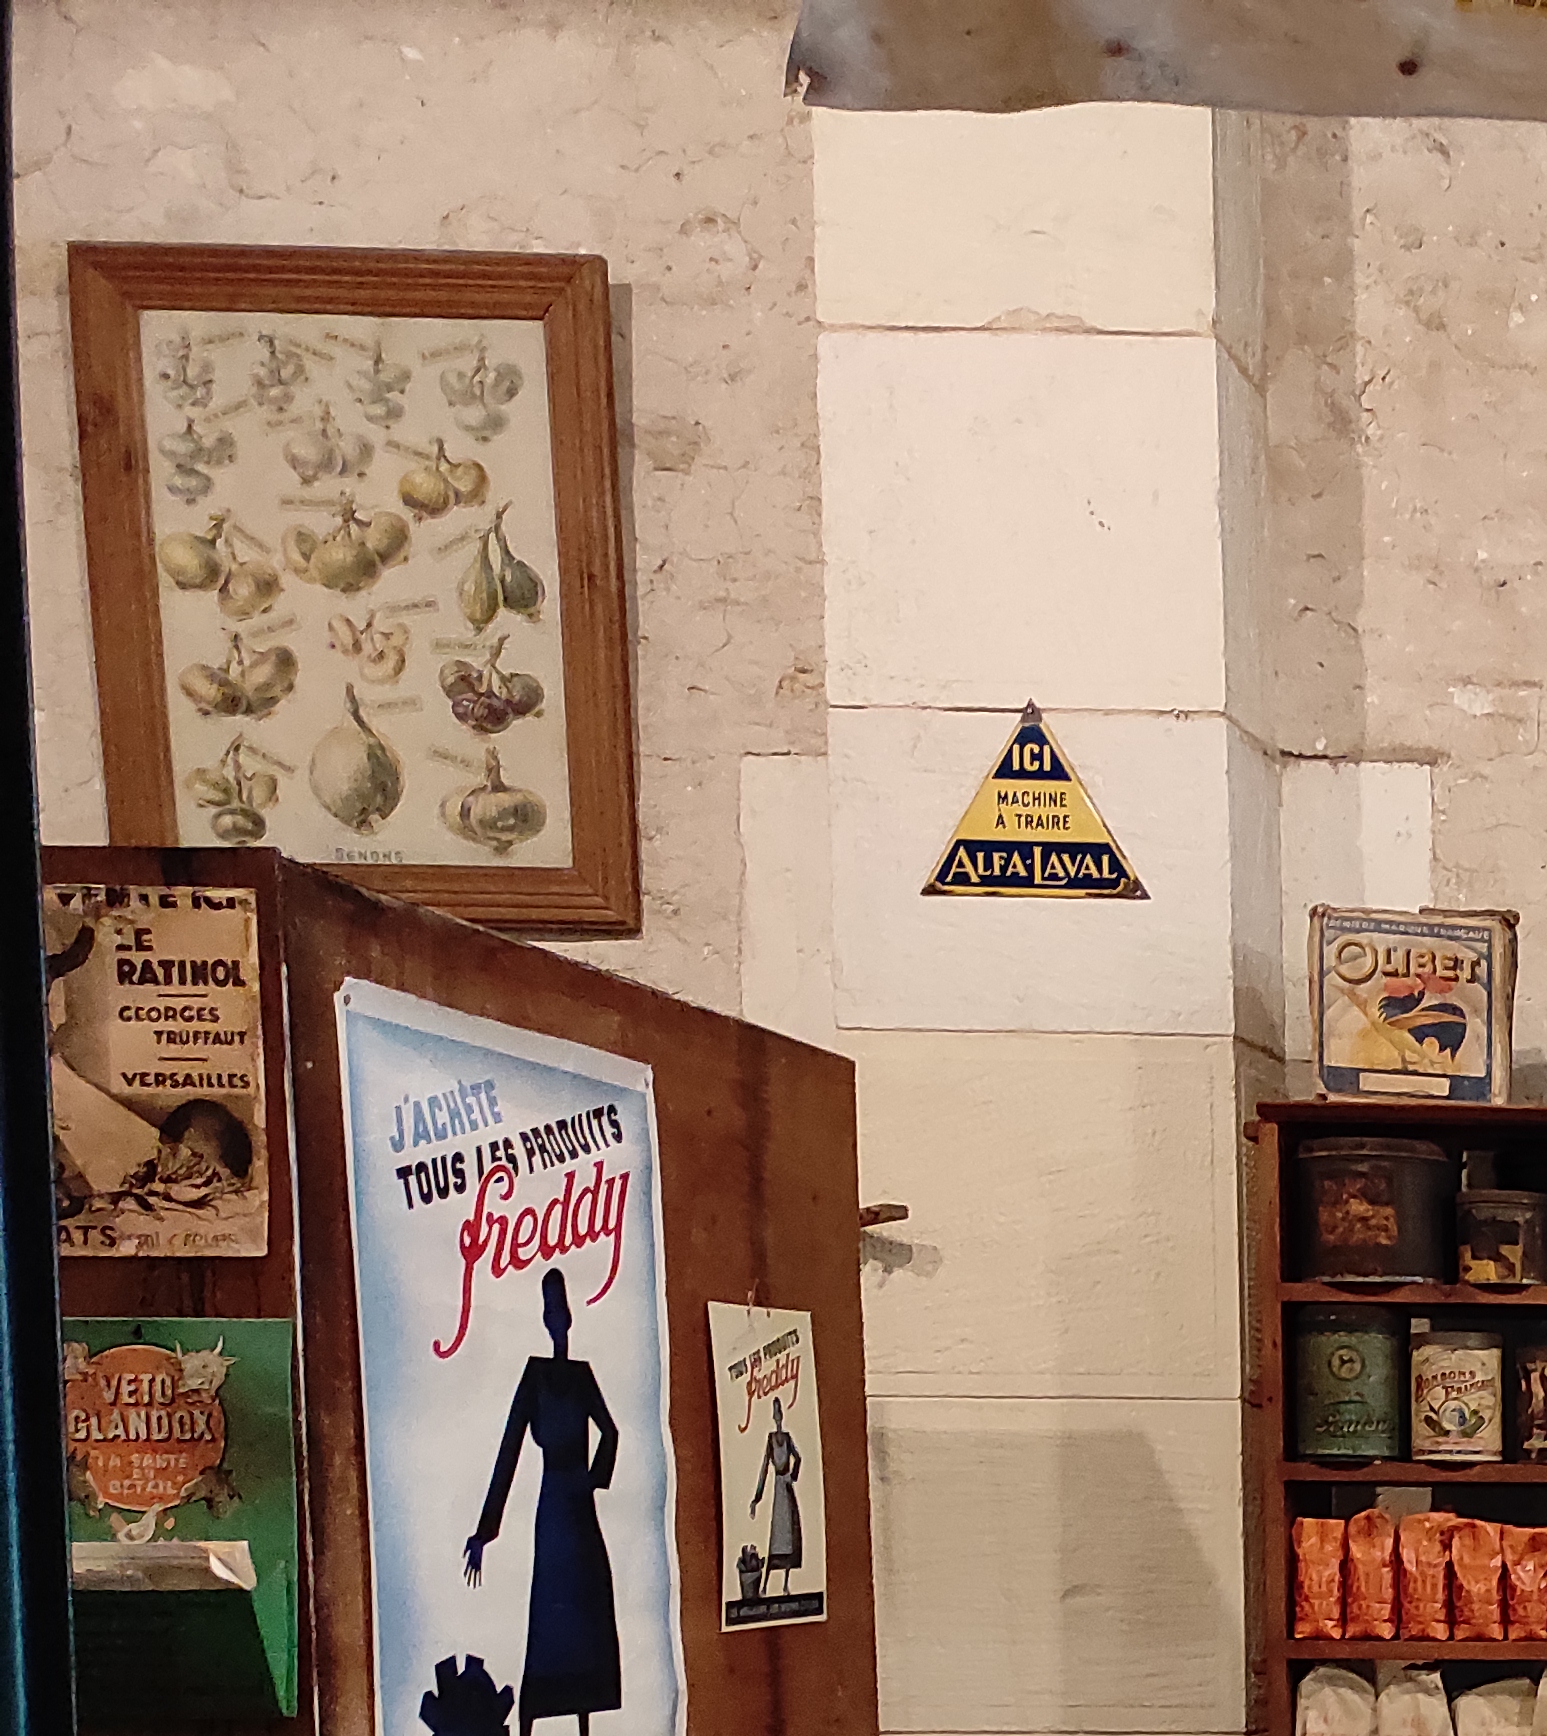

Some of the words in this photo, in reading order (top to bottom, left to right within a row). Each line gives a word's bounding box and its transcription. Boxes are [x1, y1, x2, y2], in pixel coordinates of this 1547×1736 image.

[1011, 743, 1051, 772] ICI
[996, 790, 1068, 808] MACHINE
[1015, 812, 1072, 831] TRAIRE
[944, 845, 1118, 885] ALFA-LAVAL
[116, 957, 248, 988] RATINOL
[1333, 939, 1482, 985] OLIBET
[118, 1004, 221, 1023] GEORGES
[152, 1030, 248, 1047] TRUFFAUT
[120, 1071, 251, 1090] VERSAILLES
[395, 1150, 467, 1211] TOUS
[475, 1136, 520, 1184] LES
[518, 1103, 624, 1175] PRODUITS
[101, 1372, 177, 1407] VETO
[67, 1408, 215, 1444] GLANDOX
